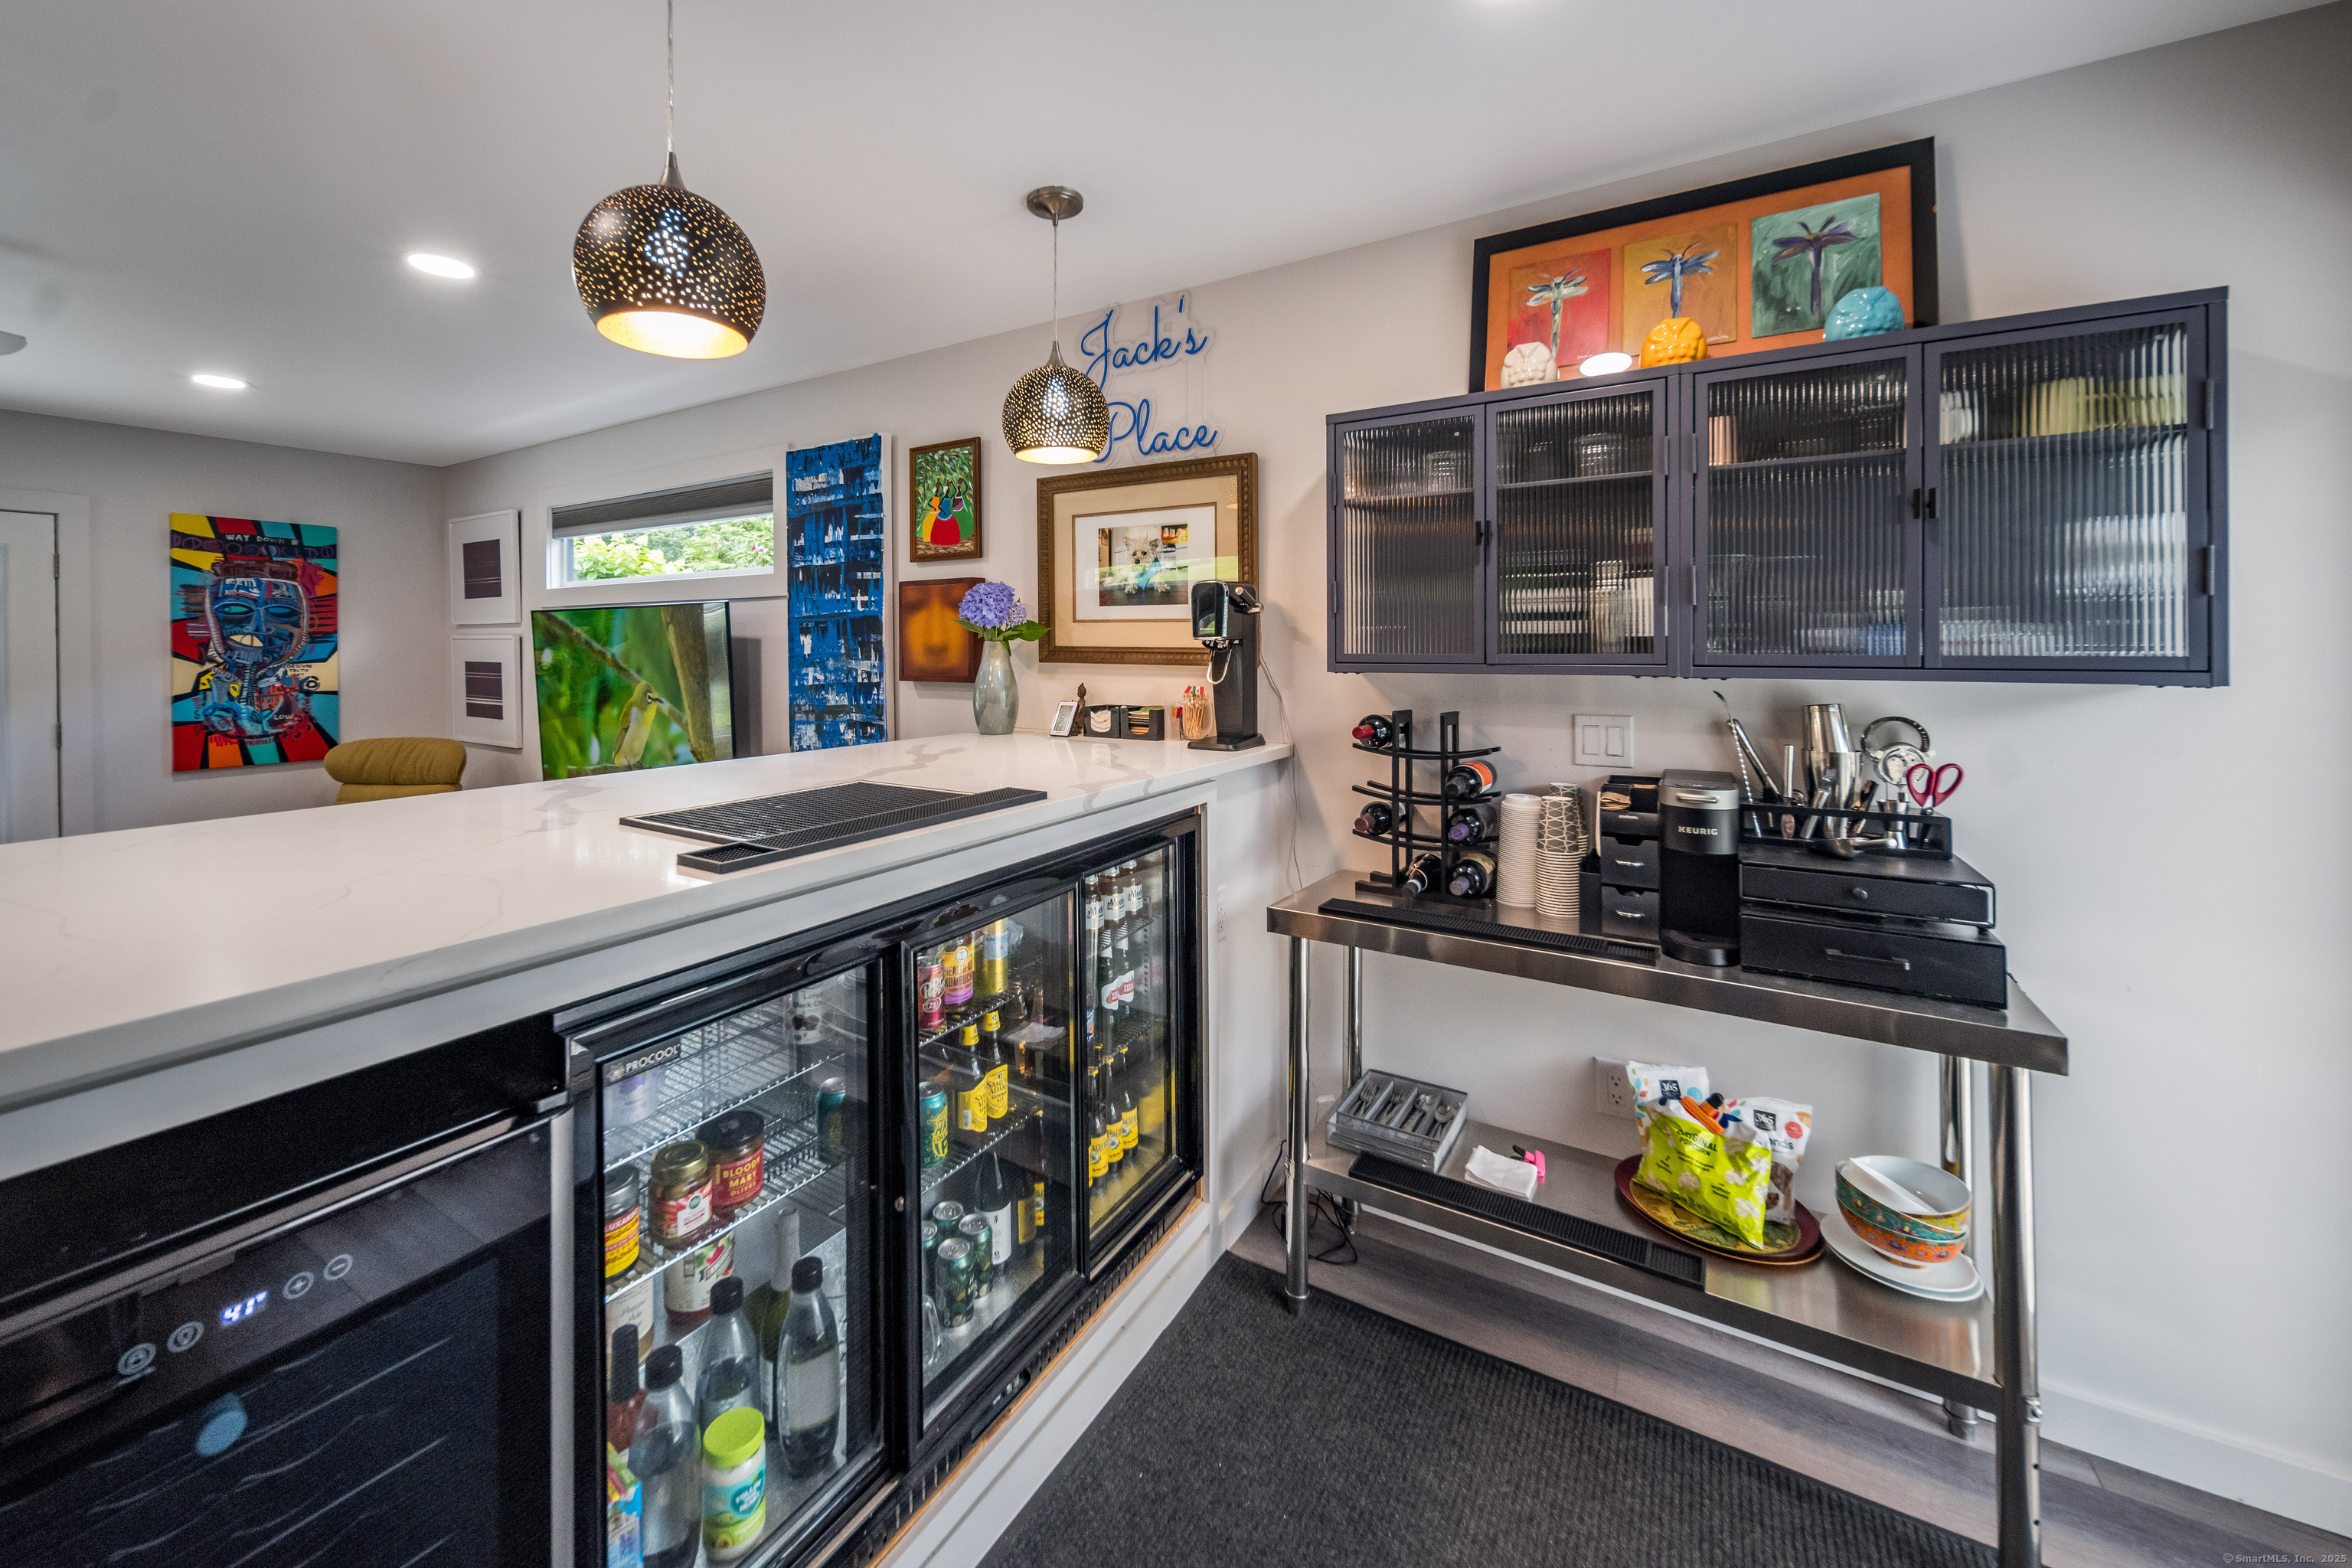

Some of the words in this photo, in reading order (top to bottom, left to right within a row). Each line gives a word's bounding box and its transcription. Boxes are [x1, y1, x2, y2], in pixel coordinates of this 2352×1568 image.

[1080, 296, 1208, 391] Jack's
[1093, 398, 1218, 464] Place
[225, 534, 250, 542] WAY
[256, 535, 285, 544] DOWN
[1677, 825, 1719, 836] KEURIG
[626, 1045, 679, 1073] PROCOOL
[1661, 1082, 1679, 1093] 365
[1755, 1112, 1775, 1125] 365
[1680, 1137, 1711, 1156] POPCORN
[722, 1155, 761, 1179] BLOODY
[729, 1169, 757, 1188] MARY
[730, 1181, 756, 1197] OLIVES
